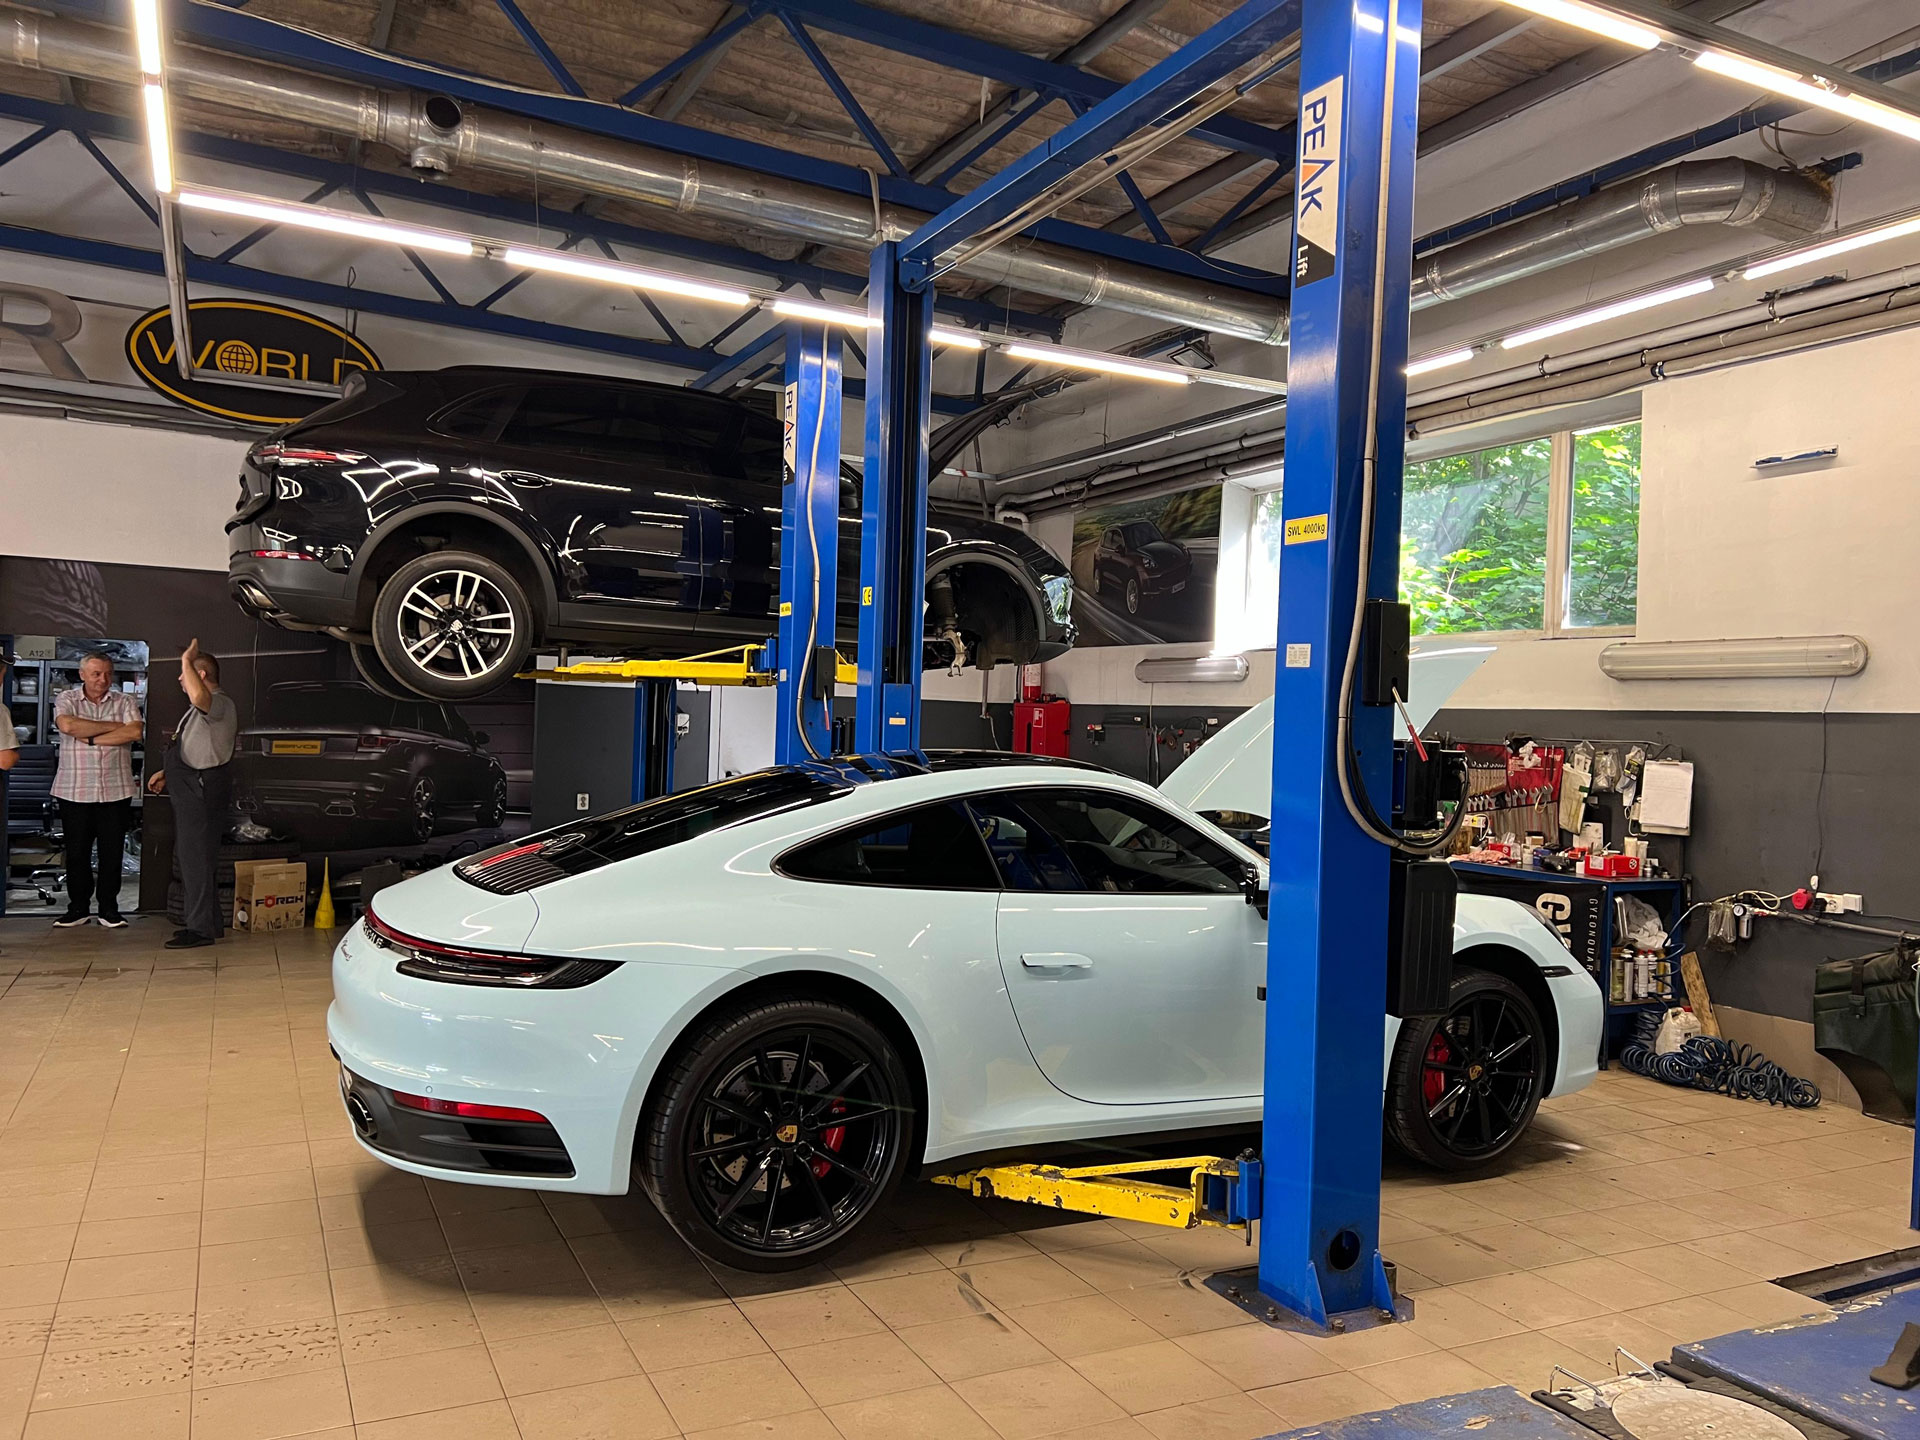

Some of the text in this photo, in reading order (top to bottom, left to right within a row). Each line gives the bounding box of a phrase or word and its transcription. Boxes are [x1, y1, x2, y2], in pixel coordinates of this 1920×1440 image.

[1297, 96, 1336, 278] PEAK Lift
[784, 390, 795, 450] PEAK
[1287, 522, 1326, 537] SWL 4000kg
